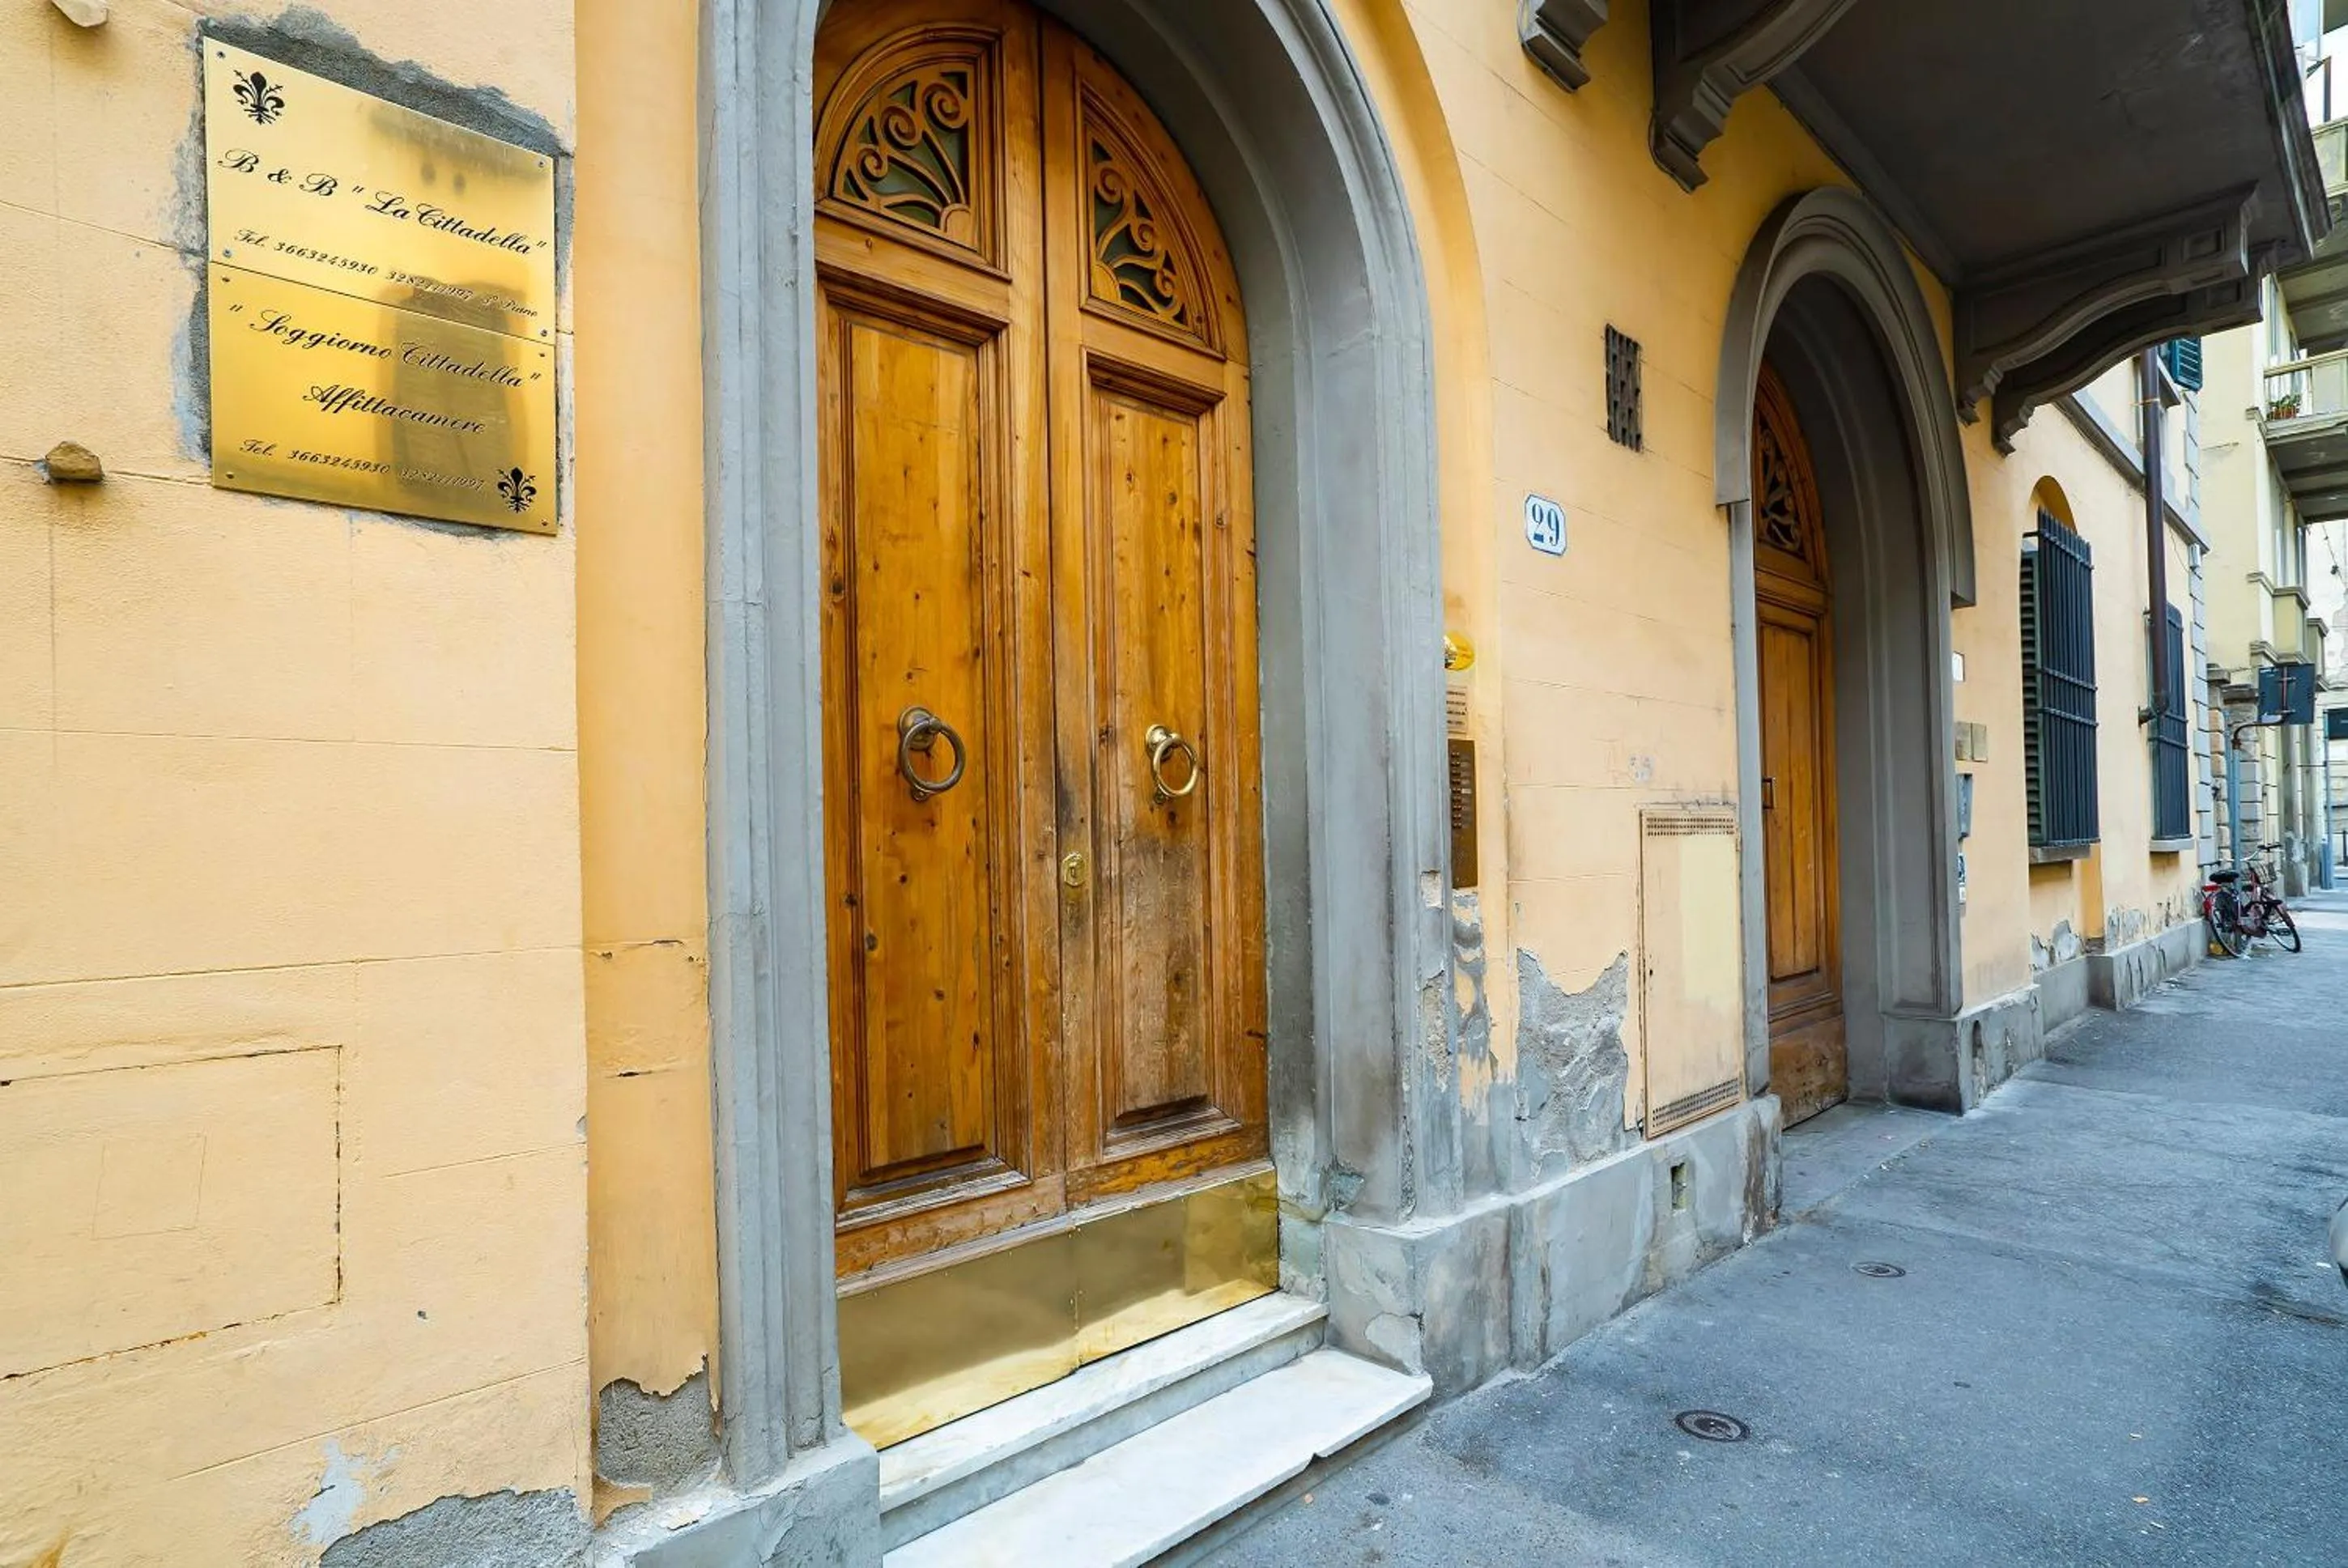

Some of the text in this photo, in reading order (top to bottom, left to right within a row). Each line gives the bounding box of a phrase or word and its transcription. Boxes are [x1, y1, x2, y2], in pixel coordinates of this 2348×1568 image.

[218, 149, 259, 172] B
[267, 168, 291, 184] &
[299, 173, 338, 196] B
[235, 229, 270, 247] Tel.
[274, 242, 379, 275] 3663245930
[249, 309, 392, 359] Soggiorno
[302, 385, 487, 434] Affittacamere
[240, 440, 275, 457] Tel.
[287, 450, 390, 474] 3663245930
[1532, 504, 1560, 546] 29
